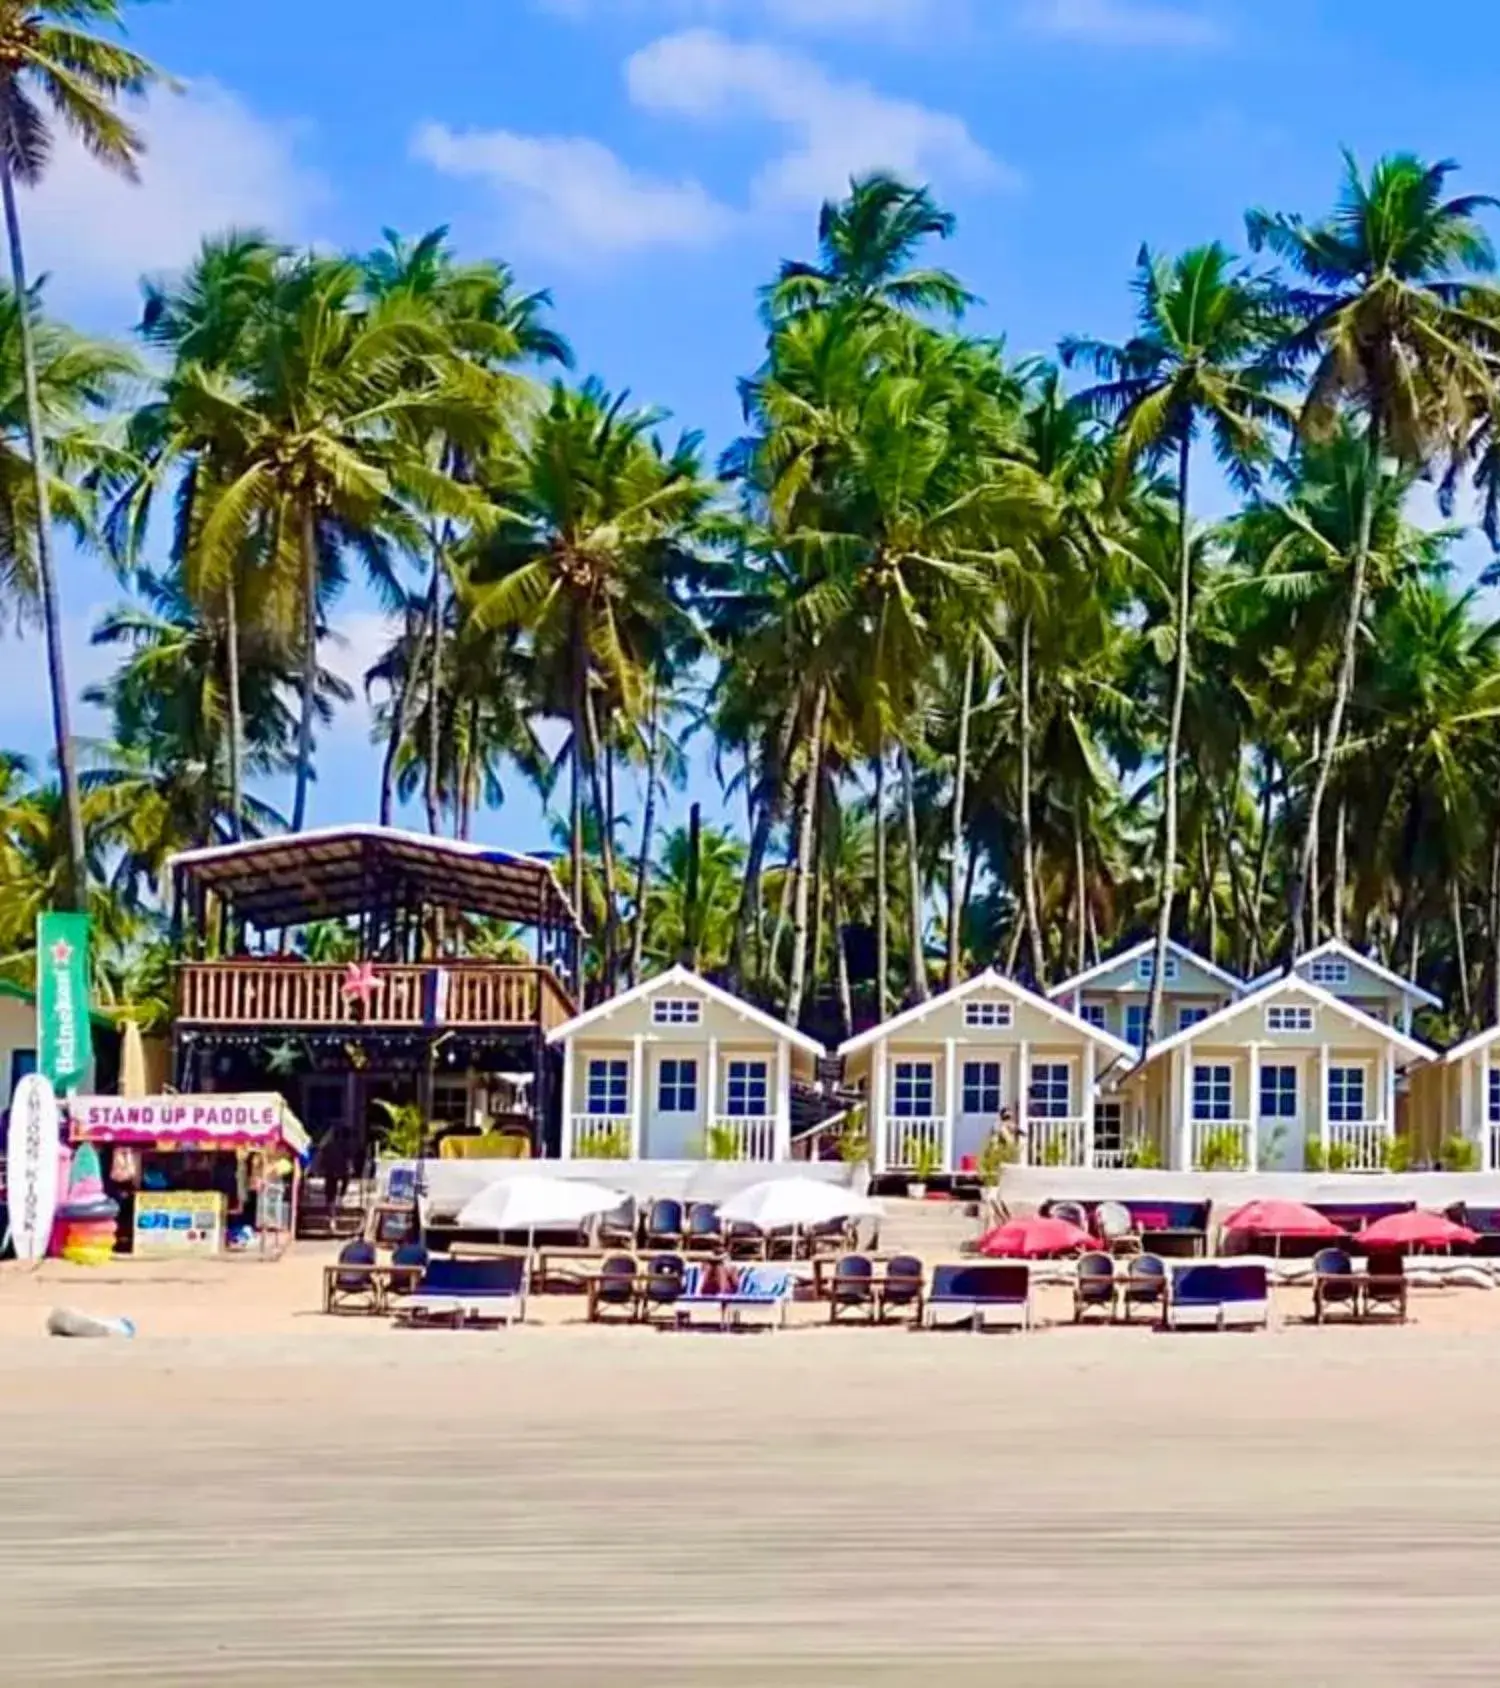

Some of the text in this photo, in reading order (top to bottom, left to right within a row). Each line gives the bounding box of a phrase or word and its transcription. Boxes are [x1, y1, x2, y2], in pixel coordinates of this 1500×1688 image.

[89, 1106, 274, 1125] STAND UP PADDLE
